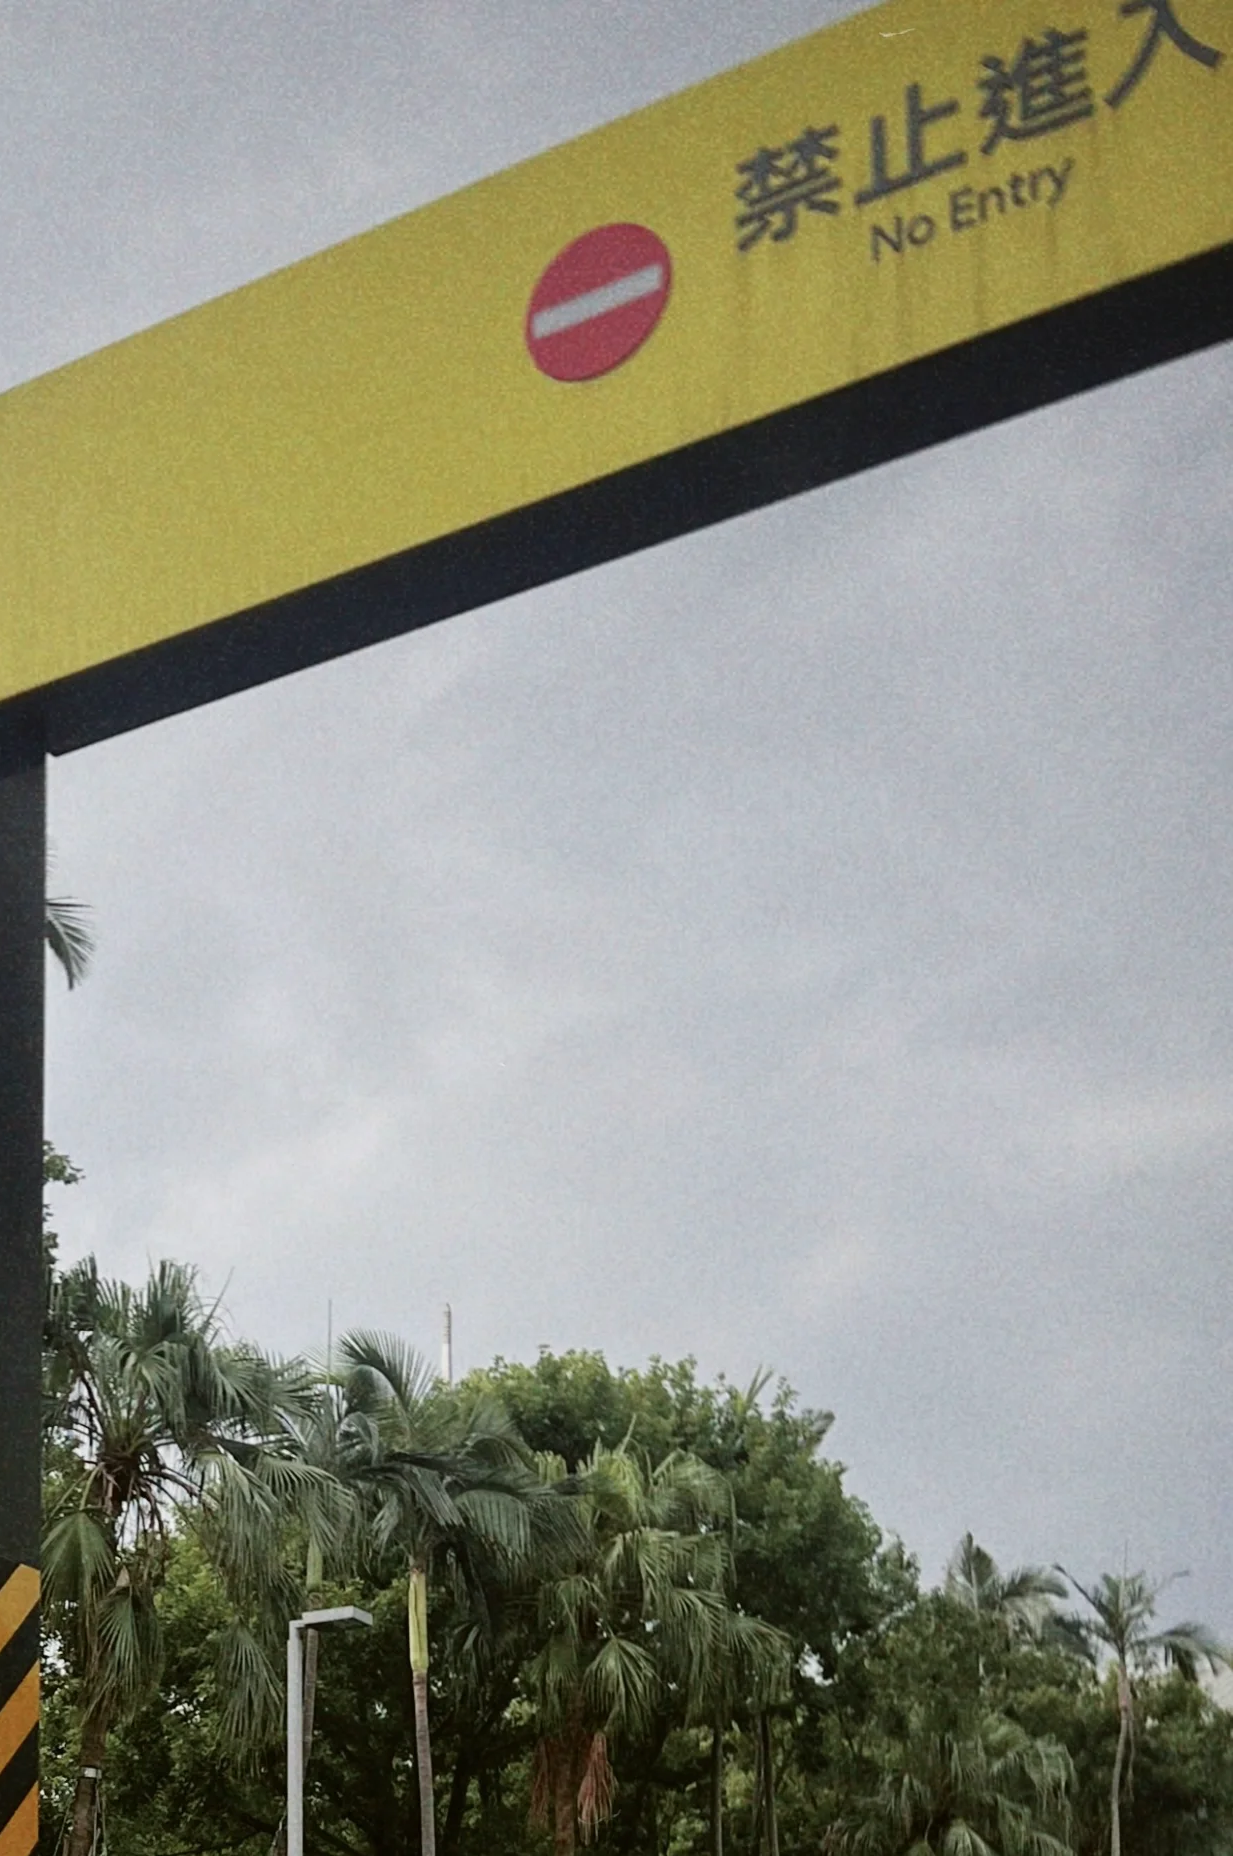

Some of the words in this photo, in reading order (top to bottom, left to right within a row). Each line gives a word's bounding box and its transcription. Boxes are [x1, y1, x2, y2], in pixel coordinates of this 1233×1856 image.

[736, 0, 1224, 252] 禁止進入
[870, 217, 934, 260] No
[950, 160, 1075, 233] Entry
